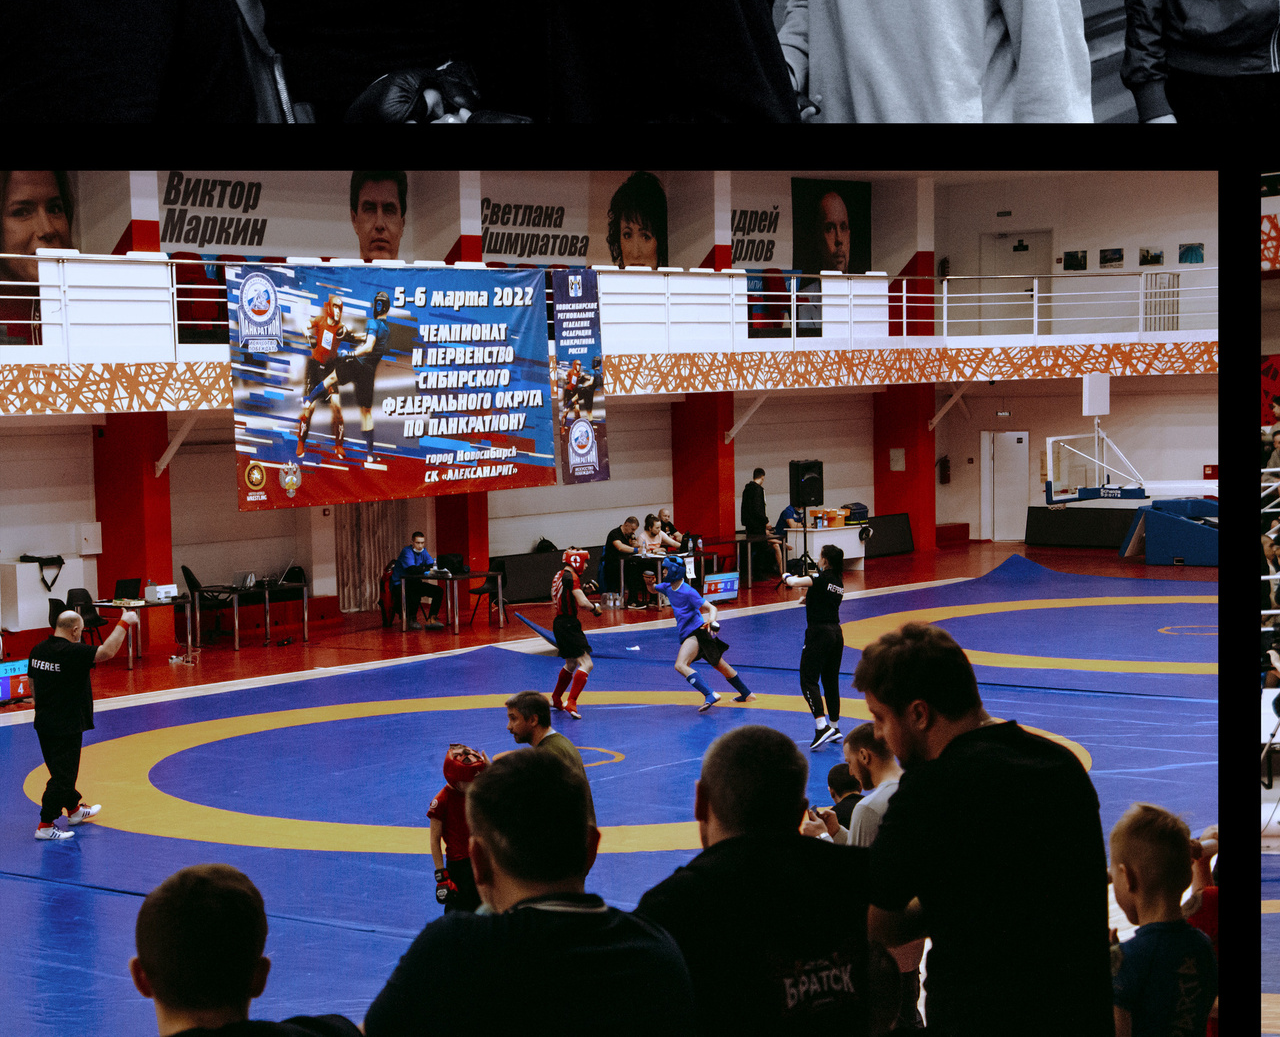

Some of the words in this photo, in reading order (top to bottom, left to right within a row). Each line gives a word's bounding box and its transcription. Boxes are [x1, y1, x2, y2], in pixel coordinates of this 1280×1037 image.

[163, 171, 262, 213] Виктор
[481, 197, 566, 229] Светлана
[160, 208, 268, 248] Маркин
[393, 286, 427, 308] 5-6
[430, 290, 489, 311] марта
[493, 286, 534, 307] 2022
[419, 323, 508, 342] ЧЕМПИОНАТ
[411, 348, 424, 367] И
[426, 346, 515, 366] ПЕРВЕНСТВО
[418, 369, 511, 390] СИБИРСКОГО
[382, 392, 492, 415] ФЕДЕРАЛЬНОГО
[495, 389, 544, 409] ОКРУГА
[403, 419, 425, 438] ПО
[428, 413, 527, 436] ПАНКРАТИОНУ
[425, 453, 454, 465] город
[456, 446, 517, 462] Новосибирск
[424, 471, 440, 483] СК
[442, 464, 518, 481] «АЛЕКСАНДРИТ»
[17, 683, 24, 695] 4
